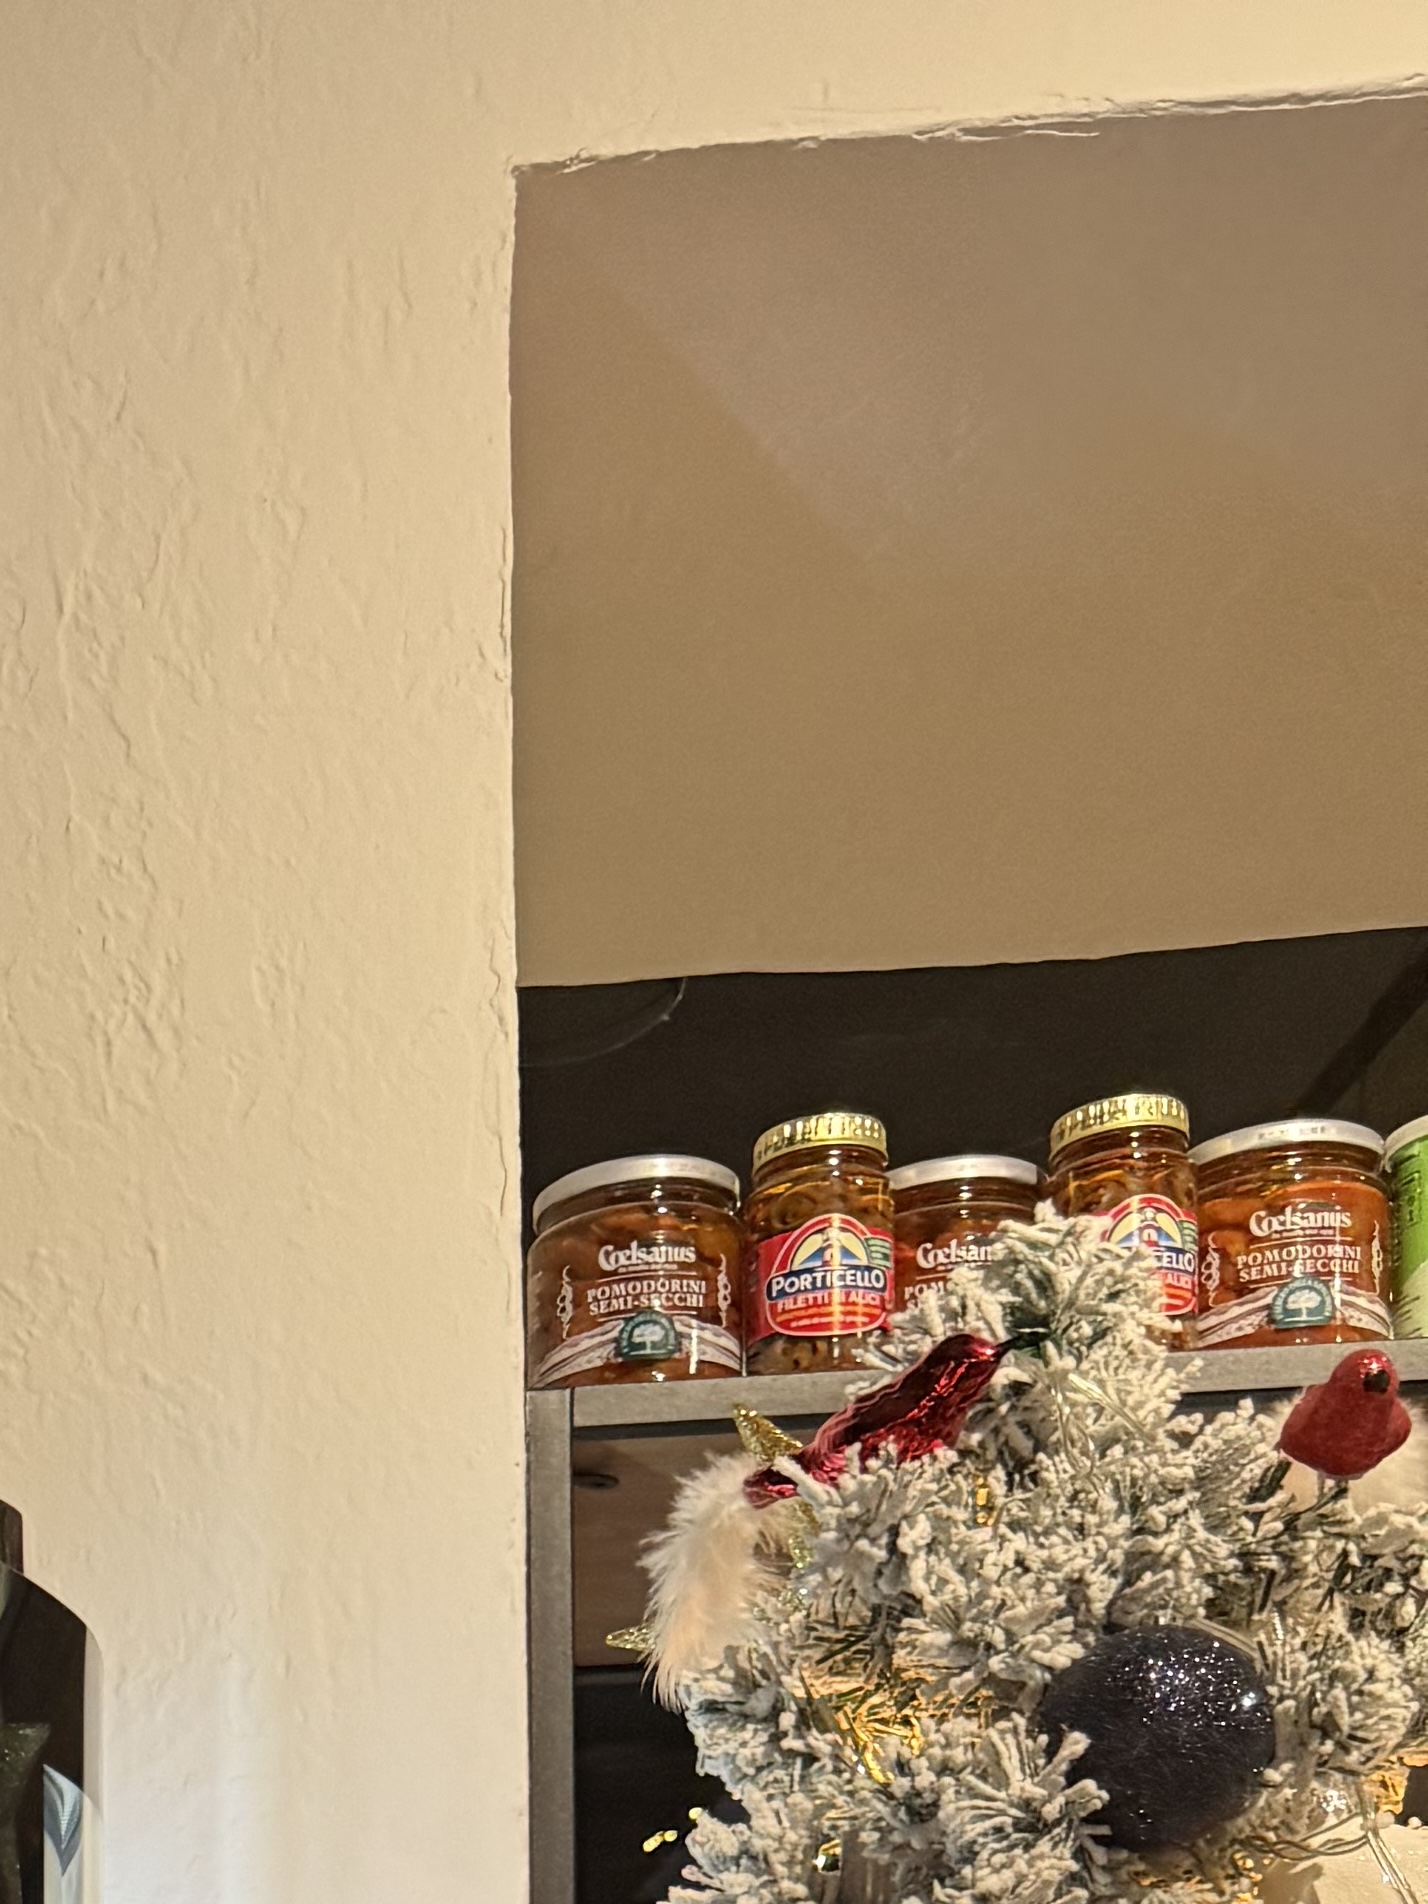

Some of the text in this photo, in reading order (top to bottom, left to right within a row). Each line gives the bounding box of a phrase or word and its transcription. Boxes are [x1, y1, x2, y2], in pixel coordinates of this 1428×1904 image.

[916, 1239, 991, 1269] Coelsan
[1237, 1244, 1361, 1269] POMODORINI
[1239, 1259, 1360, 1282] SEMI-SECCHI
[587, 1279, 706, 1302] POMODORINI
[772, 1269, 885, 1297] PORTICELLO
[589, 1293, 703, 1315] SEMI-SECCHI
